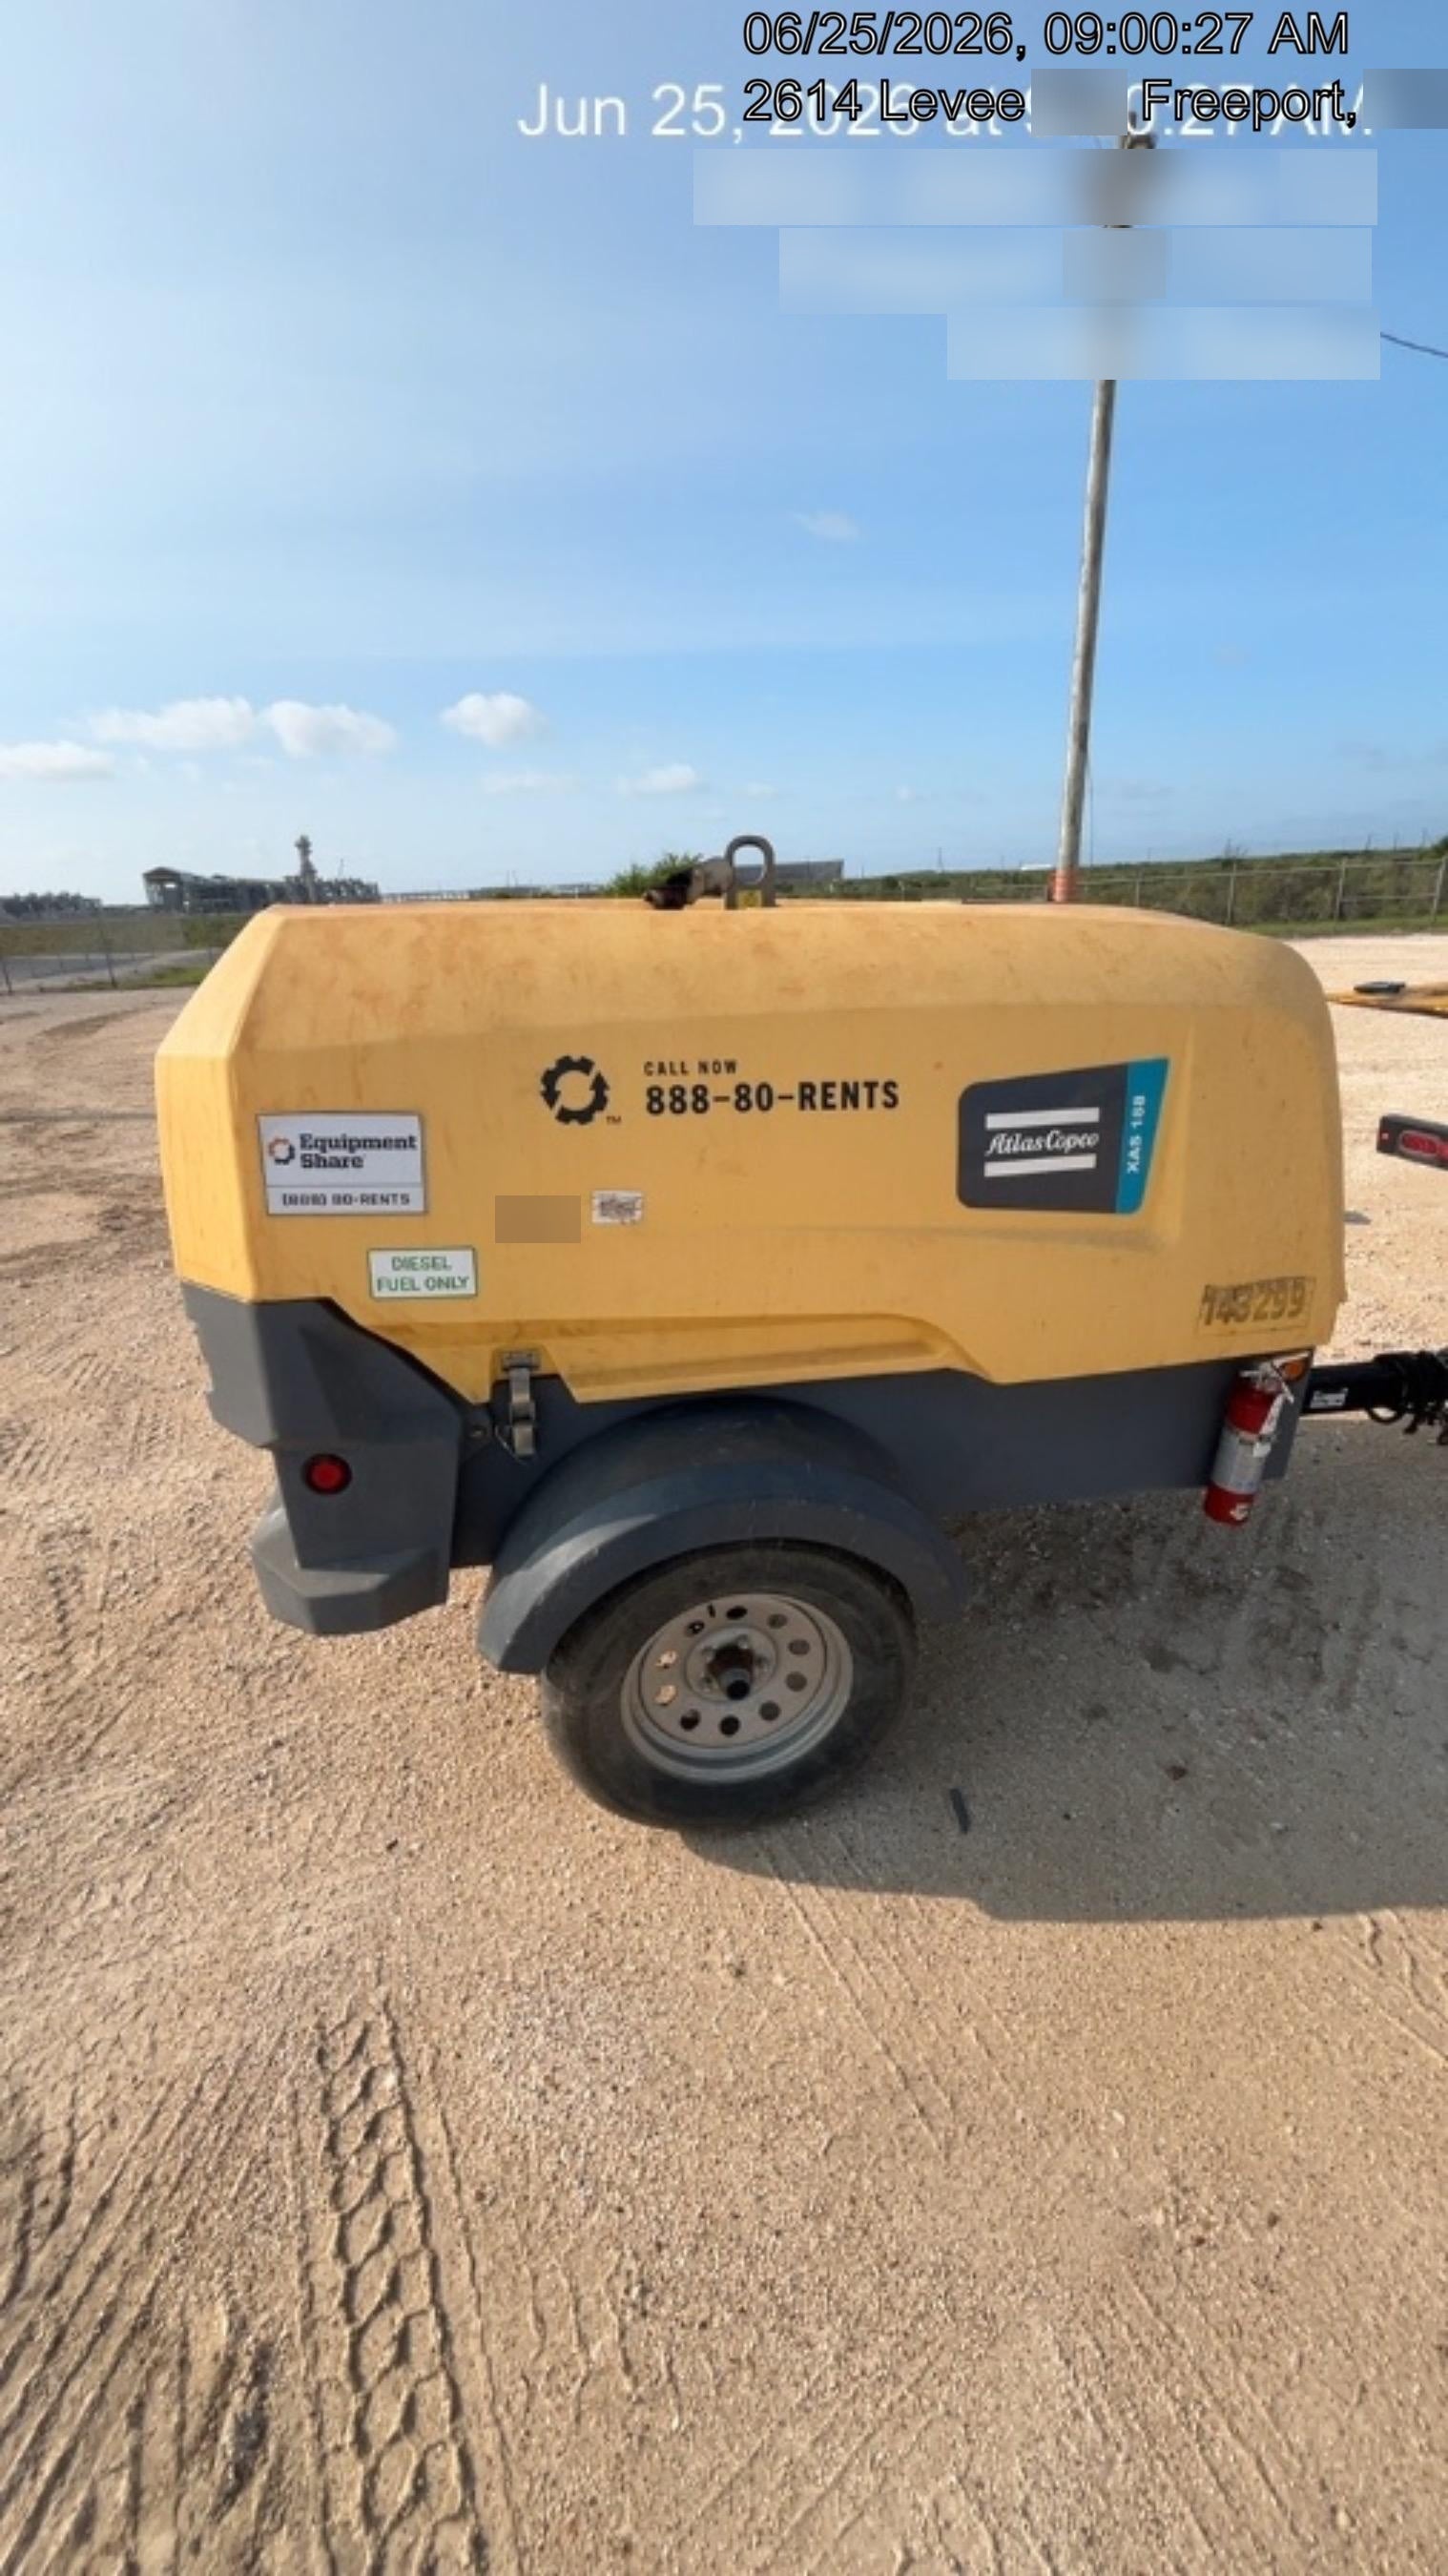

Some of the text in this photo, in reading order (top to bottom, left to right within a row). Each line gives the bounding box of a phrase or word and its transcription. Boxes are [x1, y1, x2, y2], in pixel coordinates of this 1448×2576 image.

[643, 1059, 737, 1076] CALL NOW
[645, 1080, 900, 1115] 888-80-RENTS
[299, 1133, 418, 1153] Equipment
[300, 1153, 364, 1169] Share
[1127, 1135, 1142, 1174] XAS
[391, 1256, 452, 1272] DIESEL
[377, 1276, 469, 1292] FUEL ONLY
